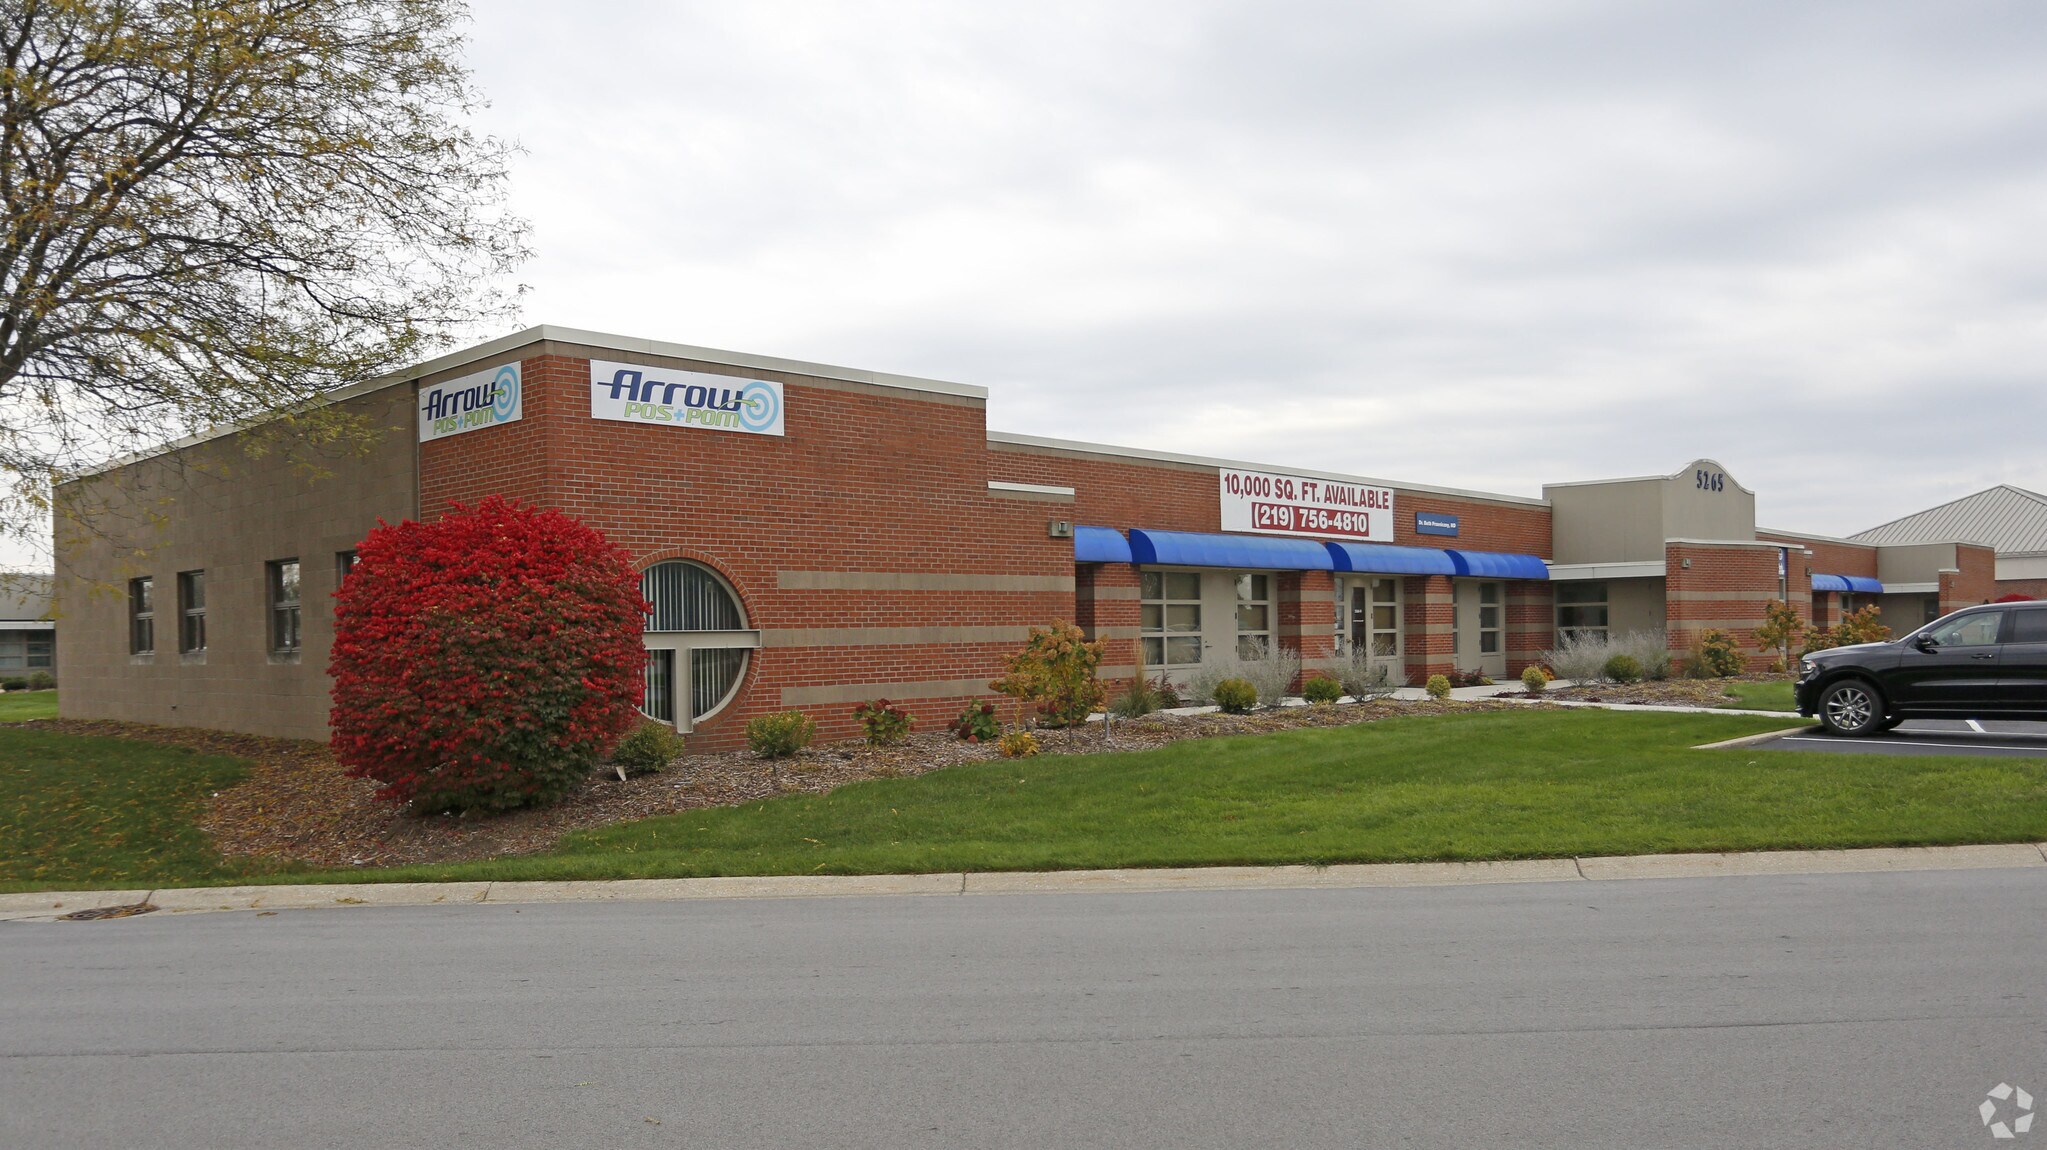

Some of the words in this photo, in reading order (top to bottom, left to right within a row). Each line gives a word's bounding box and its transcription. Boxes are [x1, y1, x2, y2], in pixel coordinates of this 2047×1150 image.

[422, 382, 495, 420] Arrow
[597, 369, 743, 411] Arrow
[1224, 473, 1270, 499] 10,000
[1275, 478, 1297, 501] SQ.
[1301, 481, 1319, 502] FT.
[1324, 484, 1389, 510] AVAILABLE
[1697, 469, 1723, 492] 5265
[1254, 503, 1294, 530] (219)
[1299, 508, 1367, 533] 756-4810
